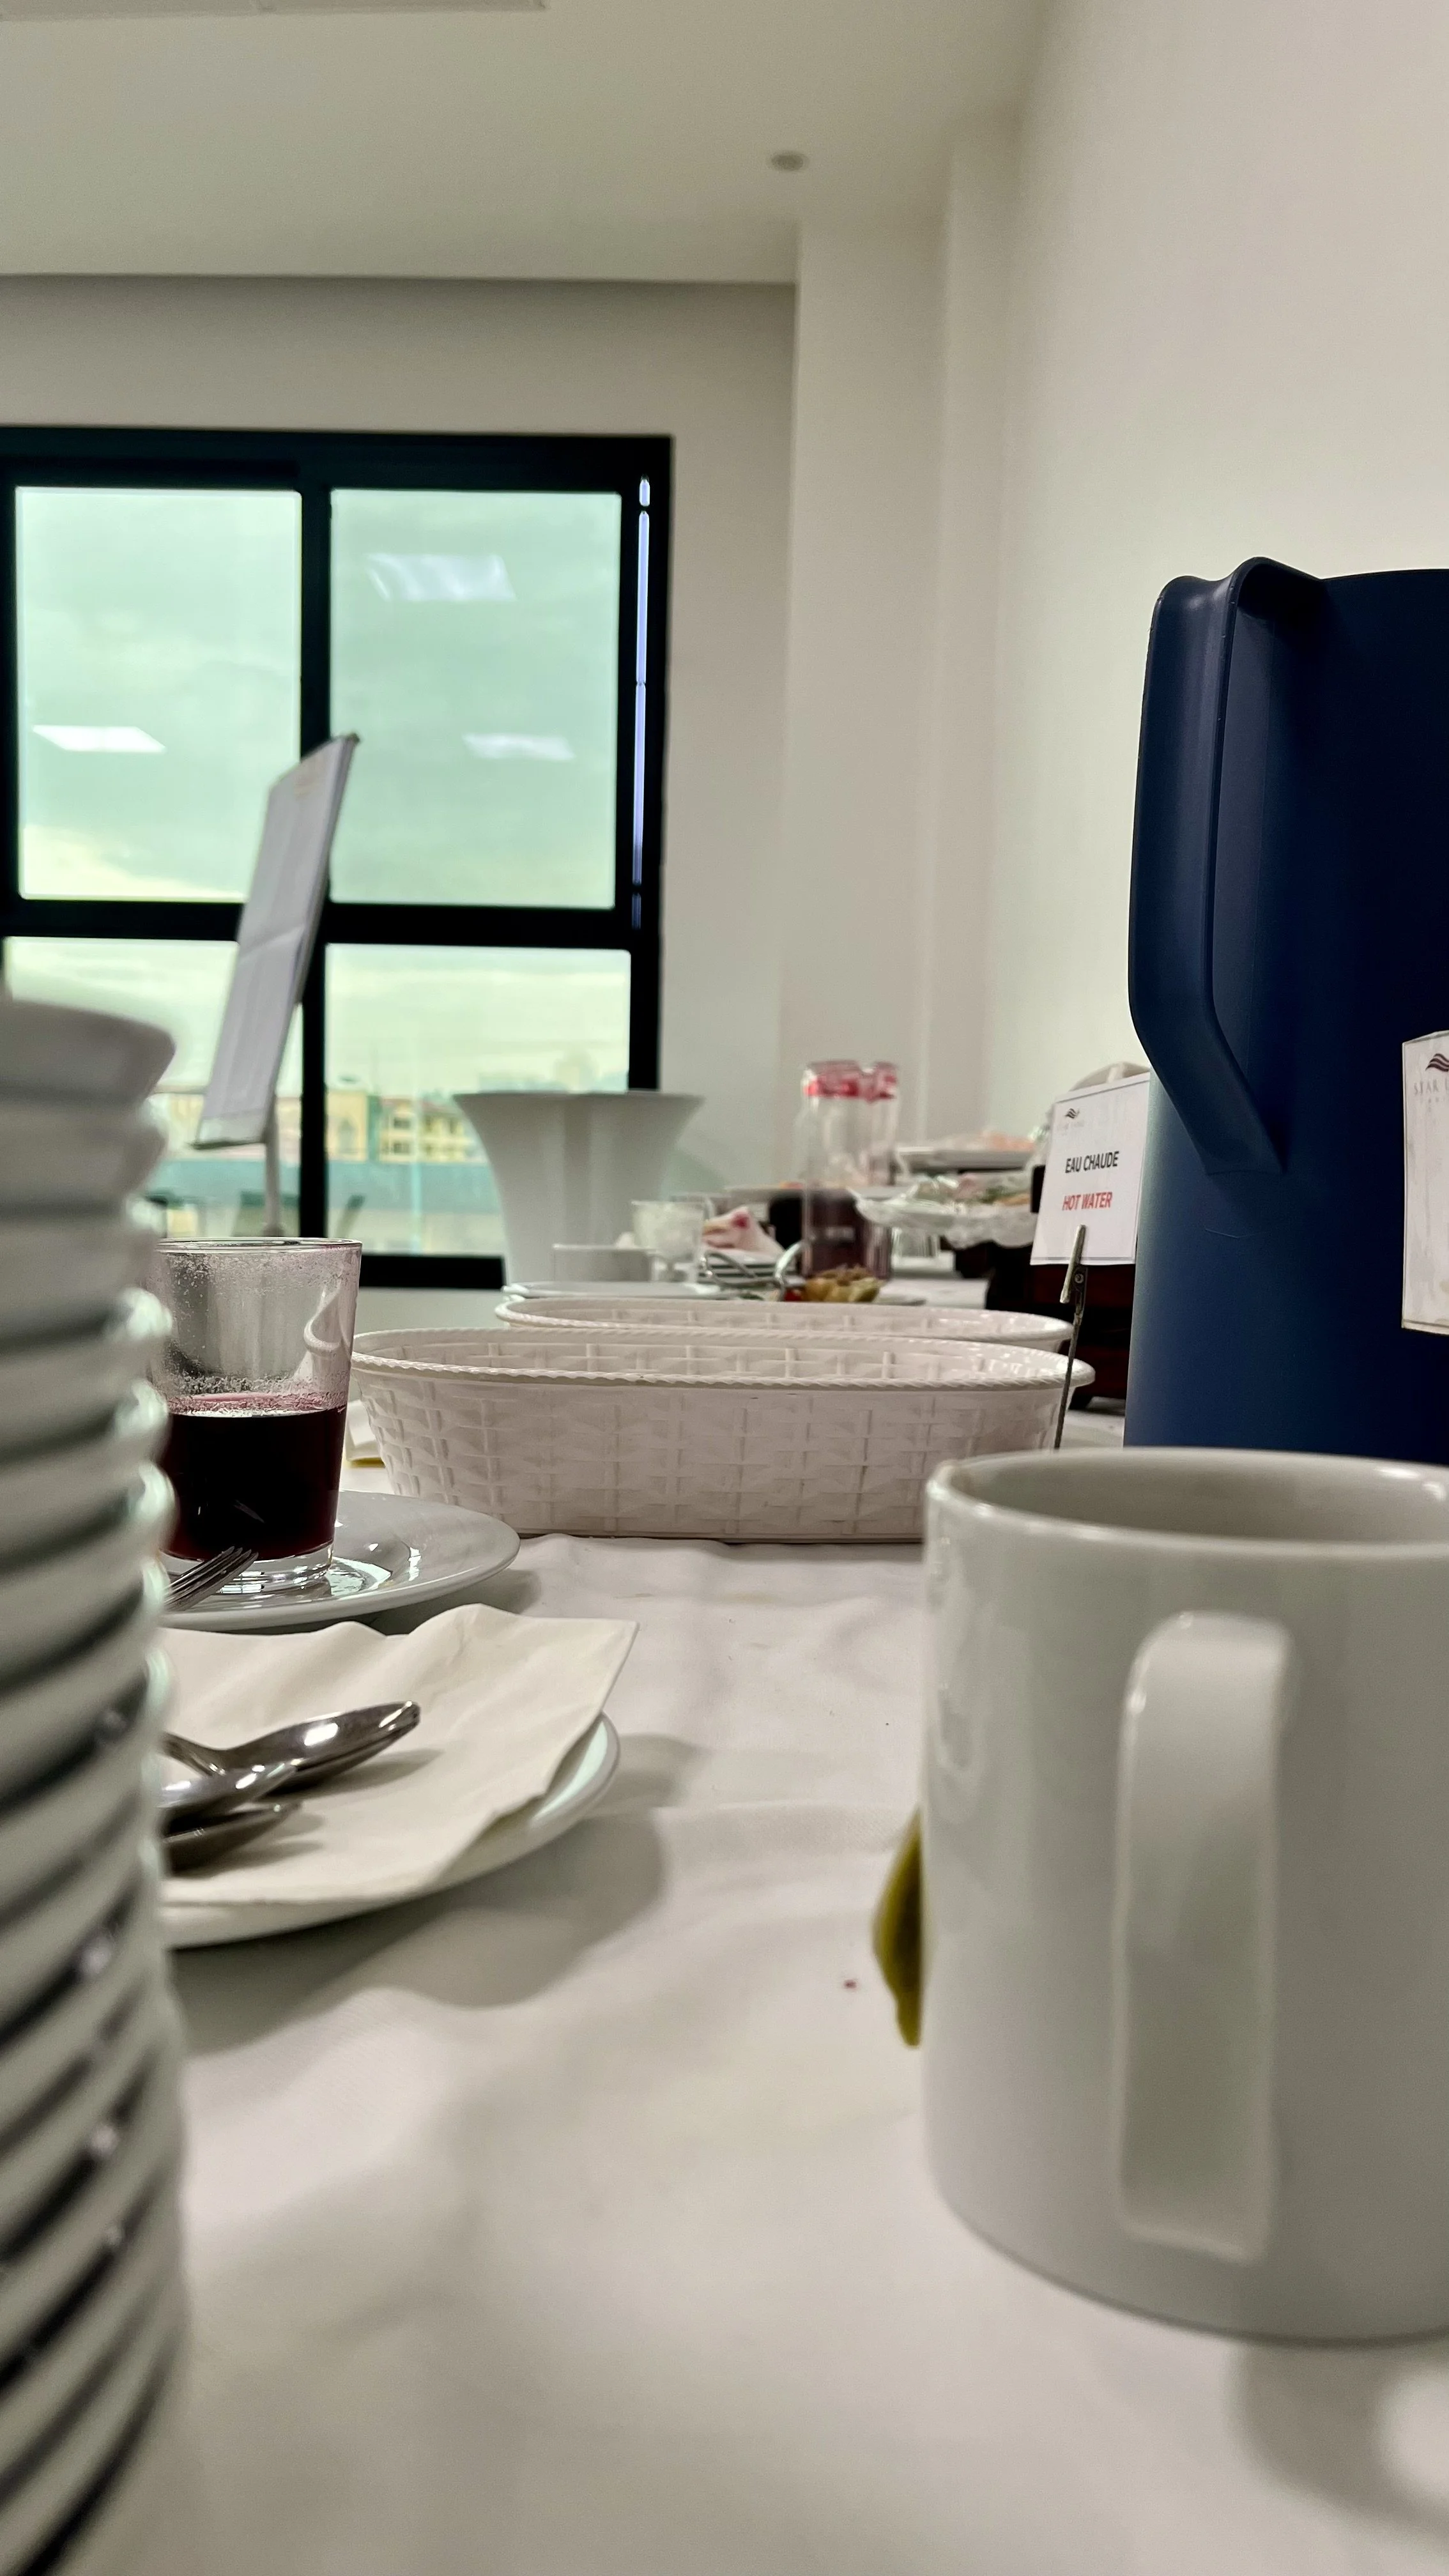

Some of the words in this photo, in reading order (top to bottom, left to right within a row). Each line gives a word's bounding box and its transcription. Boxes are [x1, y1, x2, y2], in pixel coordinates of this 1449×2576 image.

[1065, 1156, 1082, 1174] EAU
[1084, 1151, 1119, 1171] CHAUDE
[1062, 1194, 1081, 1211] HOT
[1081, 1192, 1112, 1209] WATER
